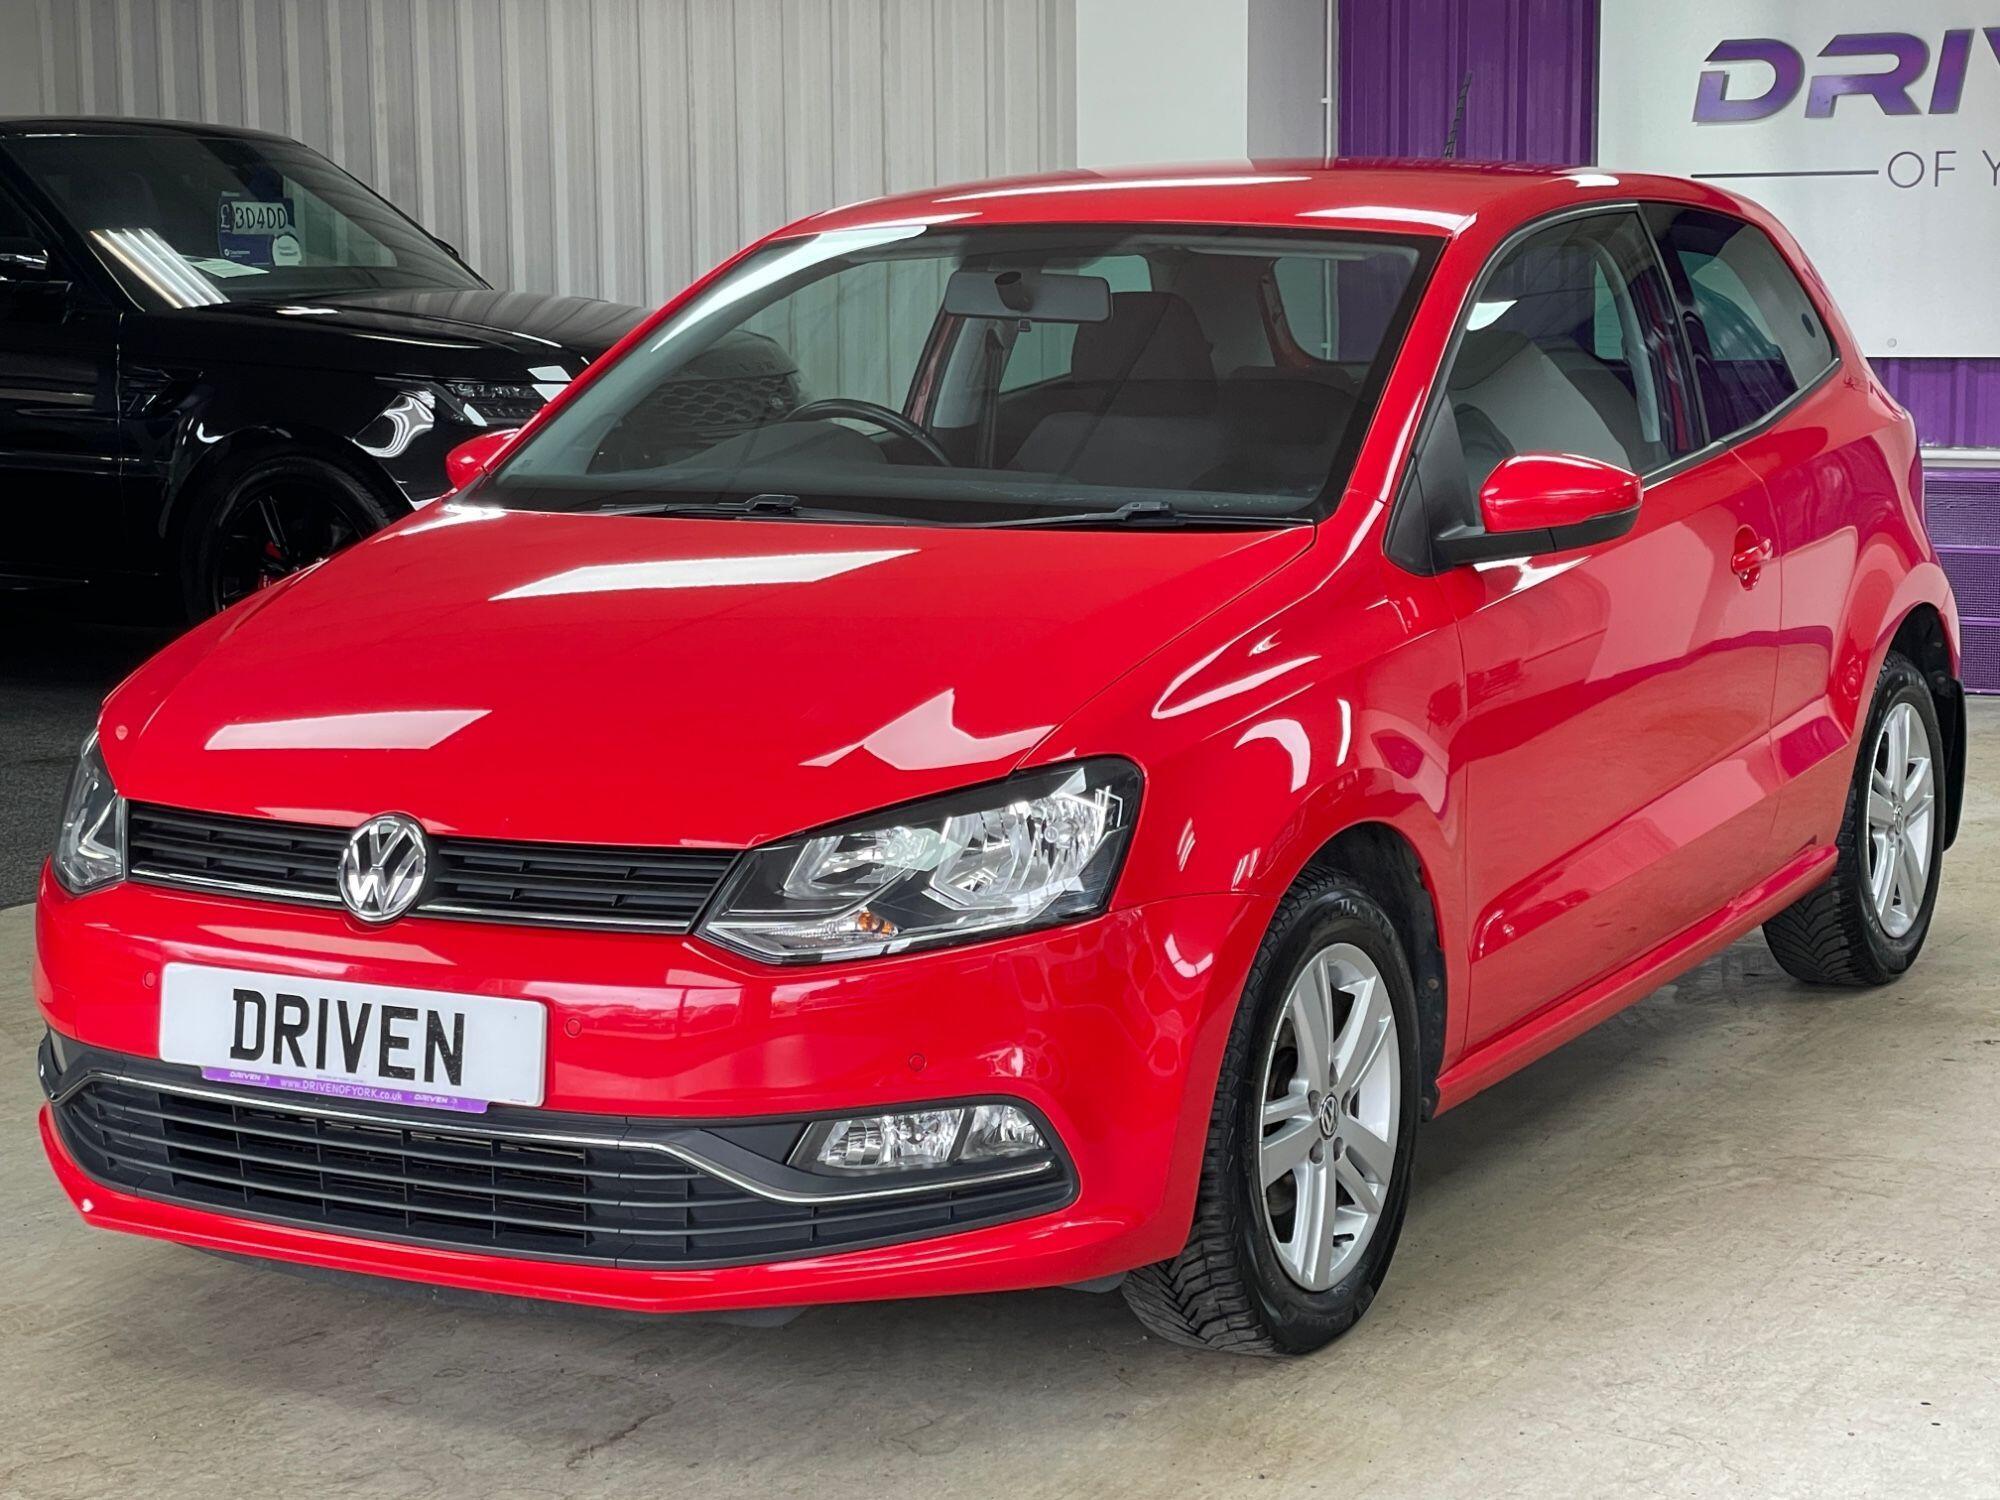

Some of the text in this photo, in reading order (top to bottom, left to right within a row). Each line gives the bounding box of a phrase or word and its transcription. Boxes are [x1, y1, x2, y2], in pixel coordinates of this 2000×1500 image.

[1692, 27, 2000, 124] DRI
[1888, 150, 1957, 188] OF
[230, 988, 465, 1086] DRIVEN
